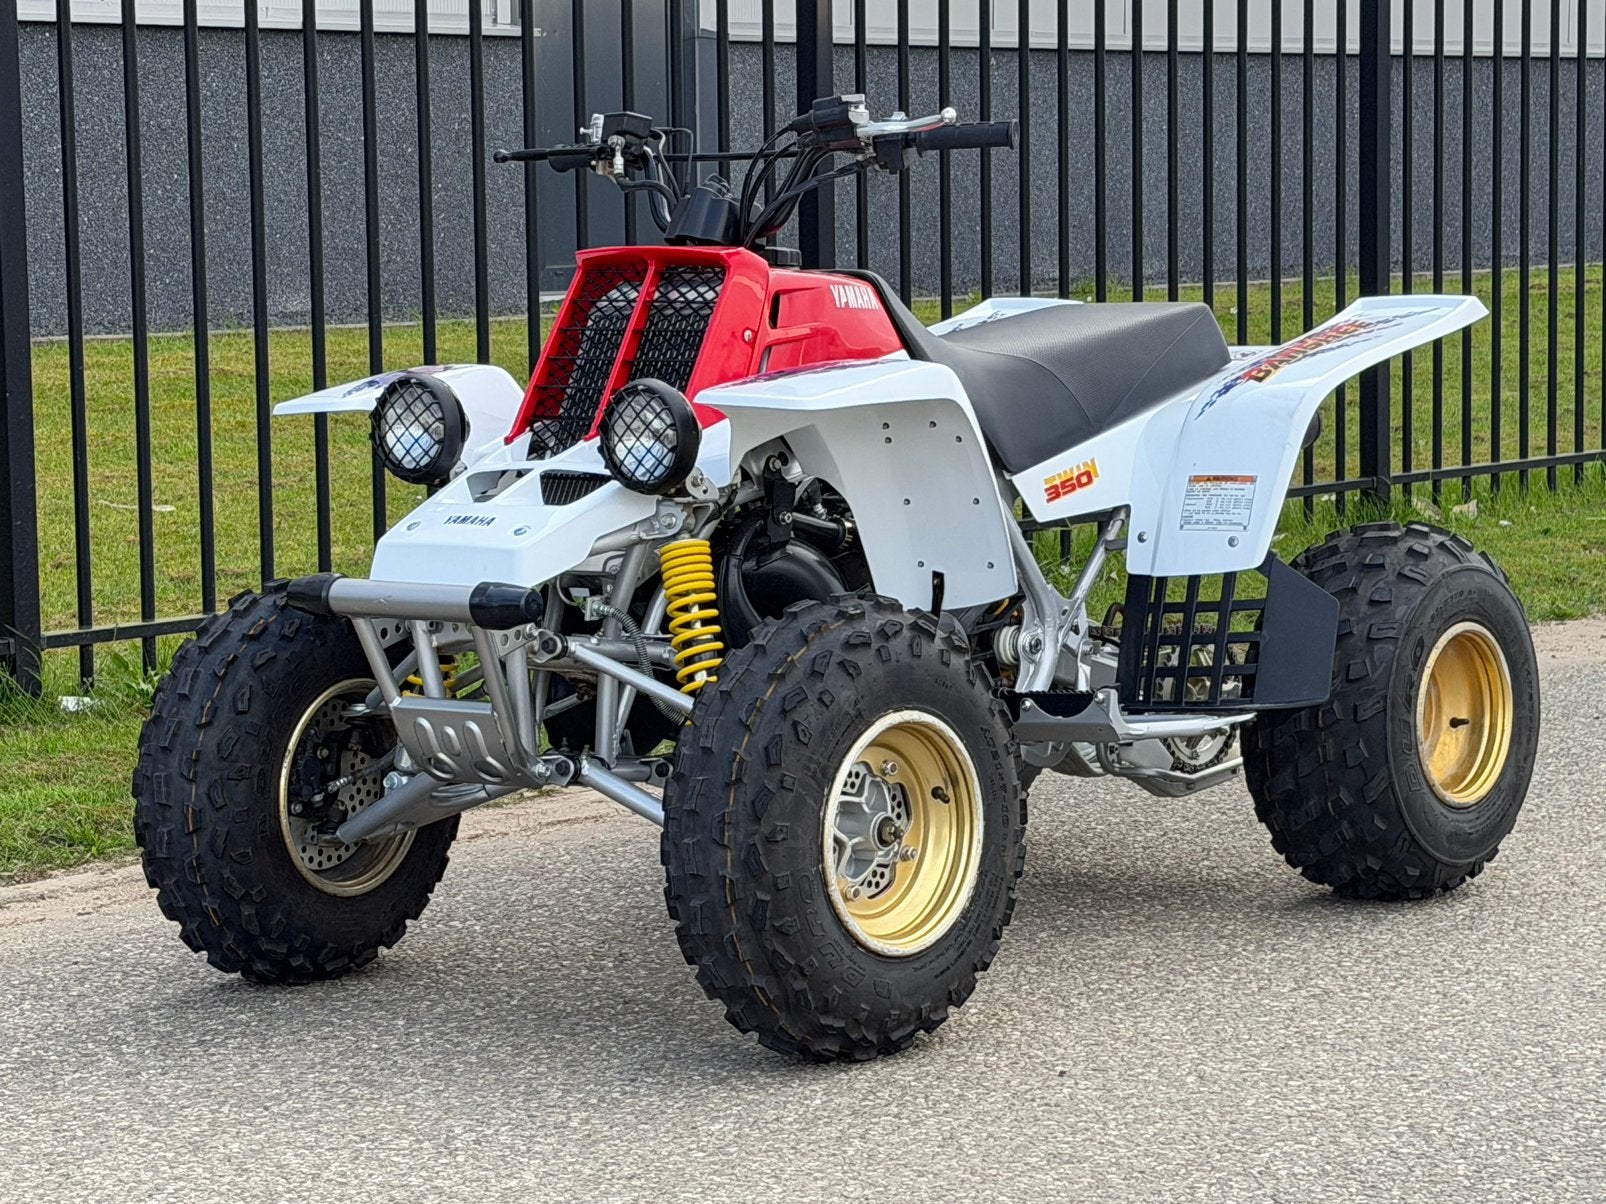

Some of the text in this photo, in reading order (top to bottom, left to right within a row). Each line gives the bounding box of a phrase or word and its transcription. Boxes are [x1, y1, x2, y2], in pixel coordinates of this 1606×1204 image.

[829, 284, 879, 310] YAMAHA
[1044, 469, 1094, 504] 350
[443, 515, 497, 527] YAMAHA
[1399, 633, 1425, 793] DURO
